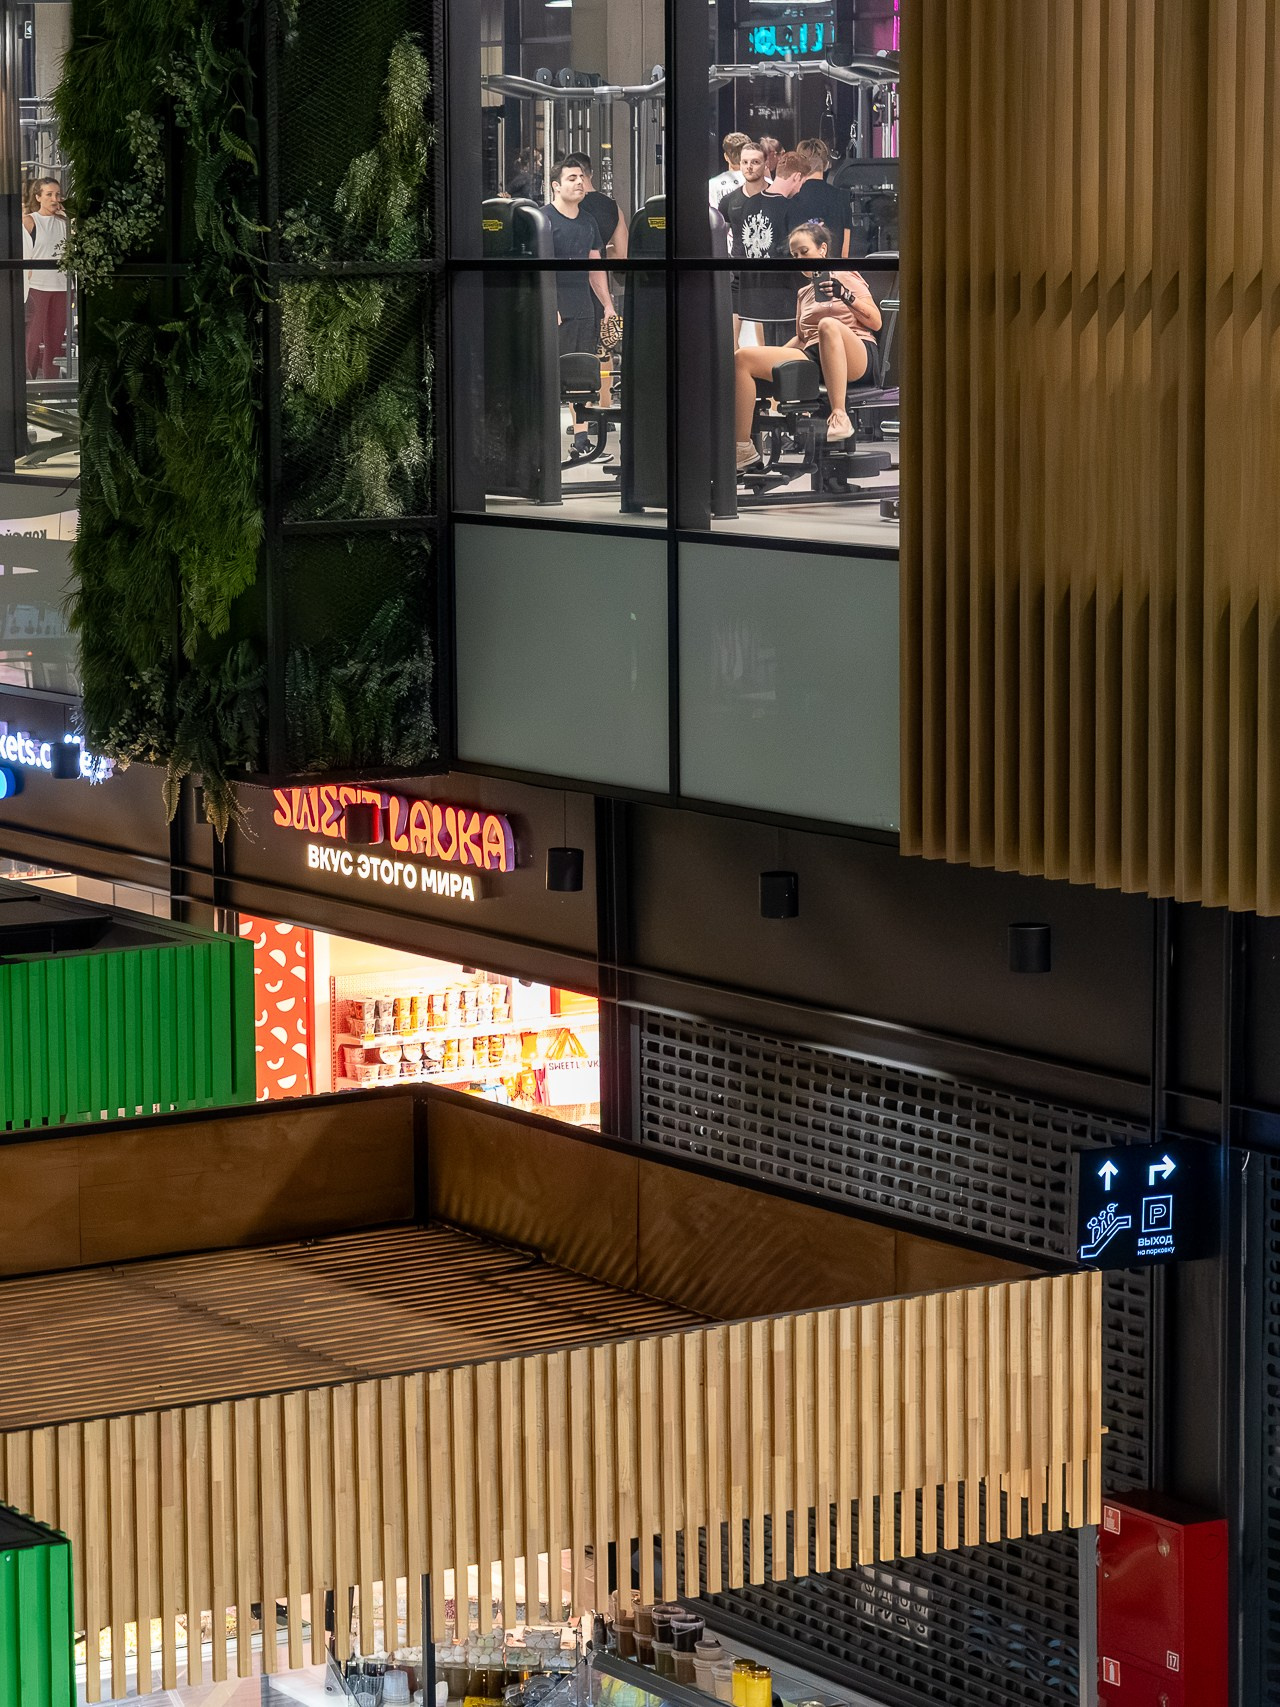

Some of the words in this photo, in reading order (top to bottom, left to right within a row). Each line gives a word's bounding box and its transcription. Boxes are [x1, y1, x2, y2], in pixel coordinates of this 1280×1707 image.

[307, 843, 354, 876] ВКУС
[356, 853, 418, 890] ЭТОГО
[421, 867, 475, 902] МИРА
